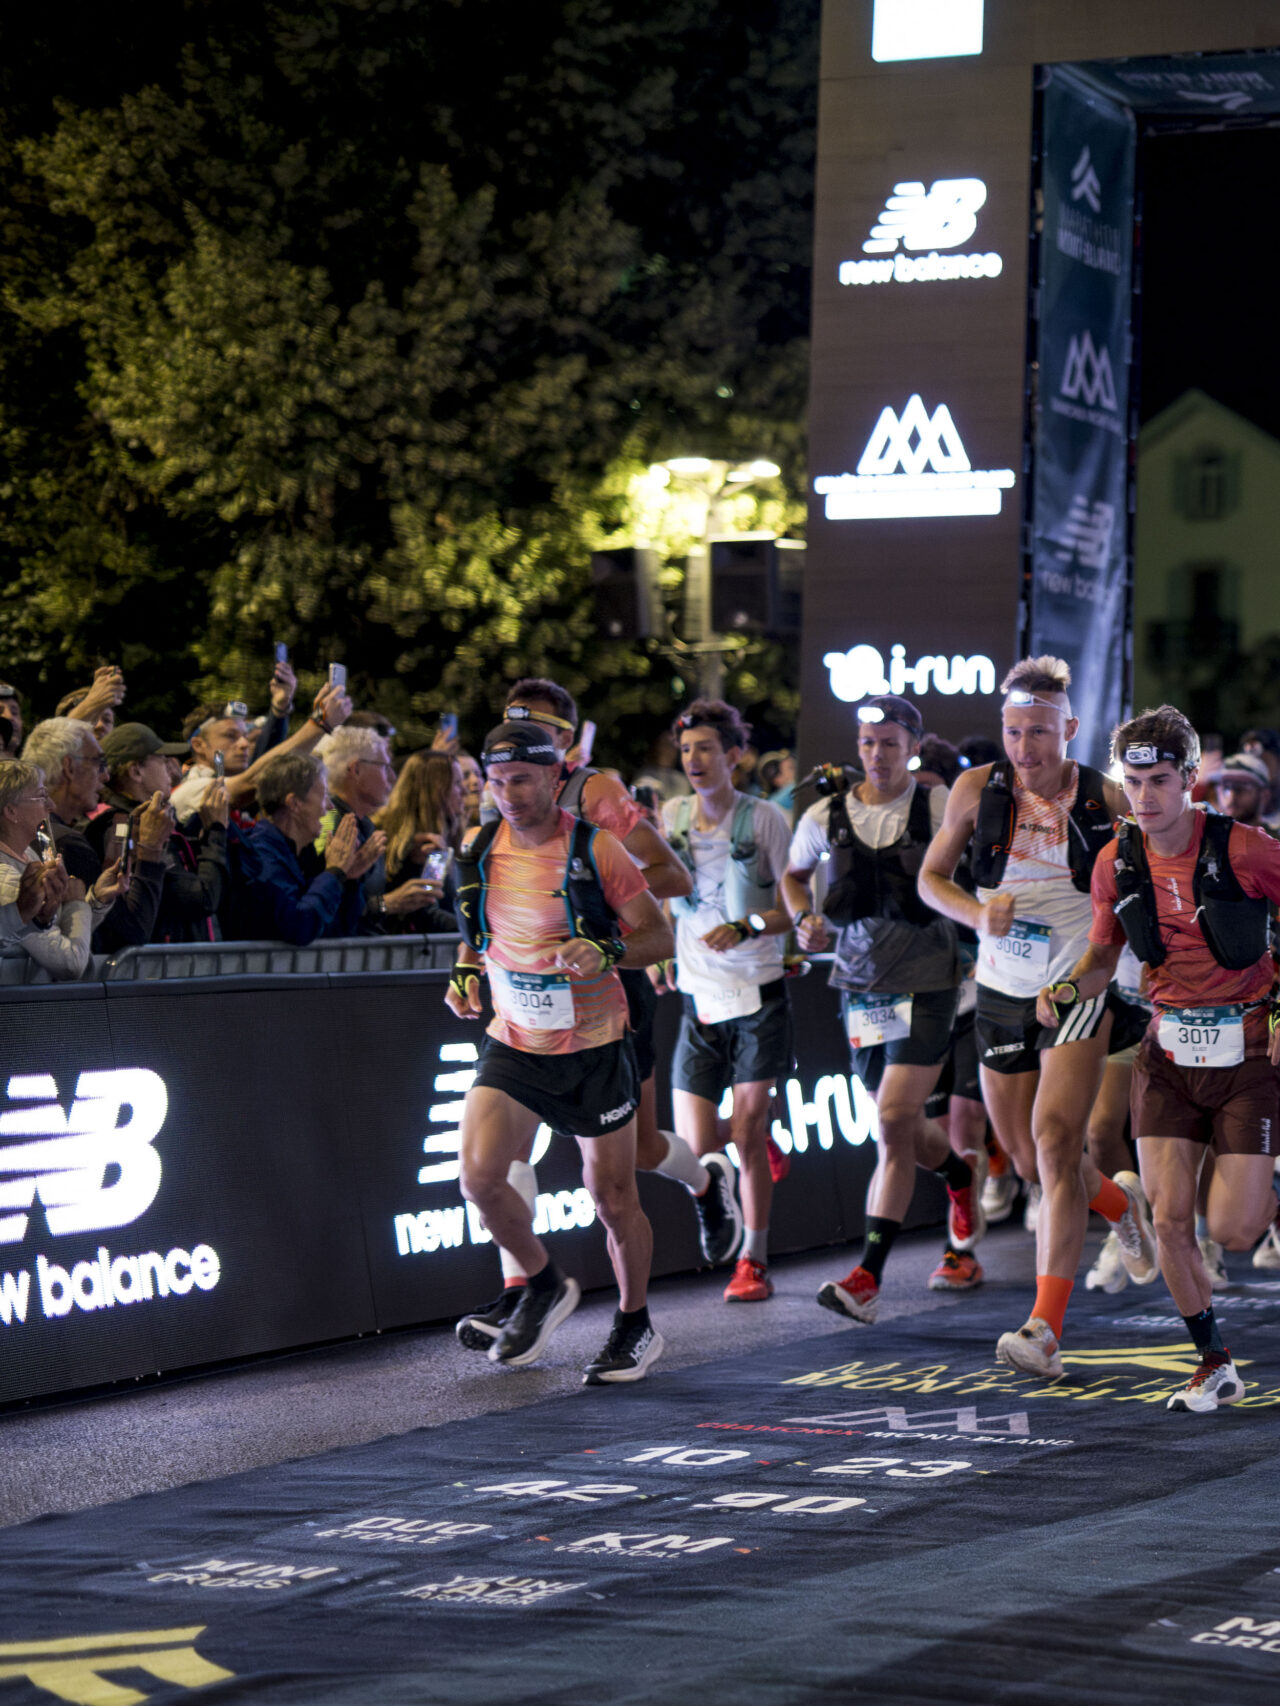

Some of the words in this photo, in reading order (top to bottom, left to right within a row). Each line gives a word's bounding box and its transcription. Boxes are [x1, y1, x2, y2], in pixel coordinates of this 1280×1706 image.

[889, 643, 996, 695] i-run
[995, 937, 1033, 959] 3002
[510, 990, 554, 1009] 3004
[862, 1008, 896, 1027] 3034
[1178, 1027, 1220, 1045] 3017
[600, 1100, 636, 1126] HOKA
[393, 1206, 465, 1256] new
[468, 1187, 596, 1247] bnce
[36, 1244, 221, 1319] balance
[623, 1446, 751, 1466] 10
[811, 1457, 973, 1479] 23
[473, 1480, 639, 1502] 42
[690, 1492, 868, 1514] 90
[344, 1516, 494, 1535] DUO
[553, 1545, 681, 1559] VERTICAL
[570, 1531, 735, 1554] KM
[181, 1559, 341, 1580] MINI
[146, 1572, 292, 1590] CROSS
